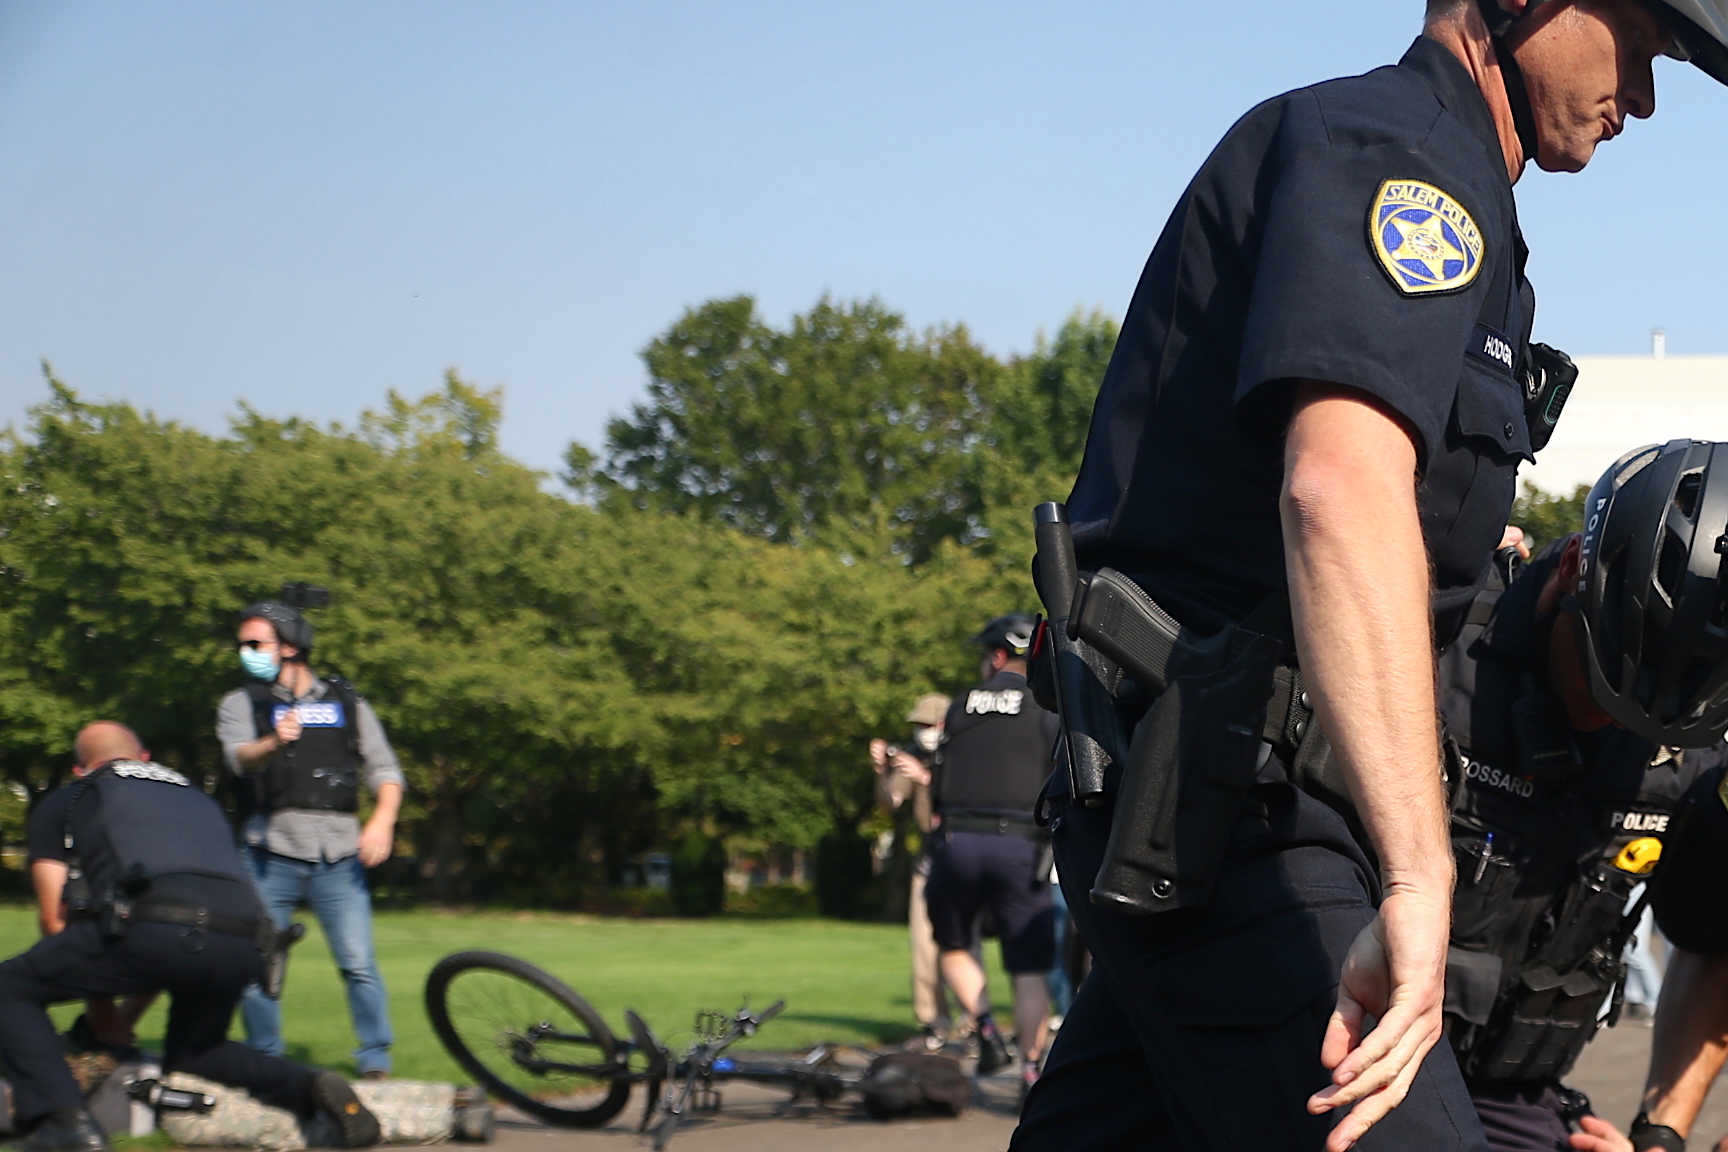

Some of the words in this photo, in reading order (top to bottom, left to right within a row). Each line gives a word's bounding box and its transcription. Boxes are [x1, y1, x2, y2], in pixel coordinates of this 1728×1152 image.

[1384, 185, 1440, 209] SALEM
[1441, 199, 1480, 254] POLICE
[1578, 498, 1607, 592] POLICE
[965, 689, 1024, 714] POLICE
[274, 704, 339, 725] PESS
[1610, 811, 1670, 832] POLICE
